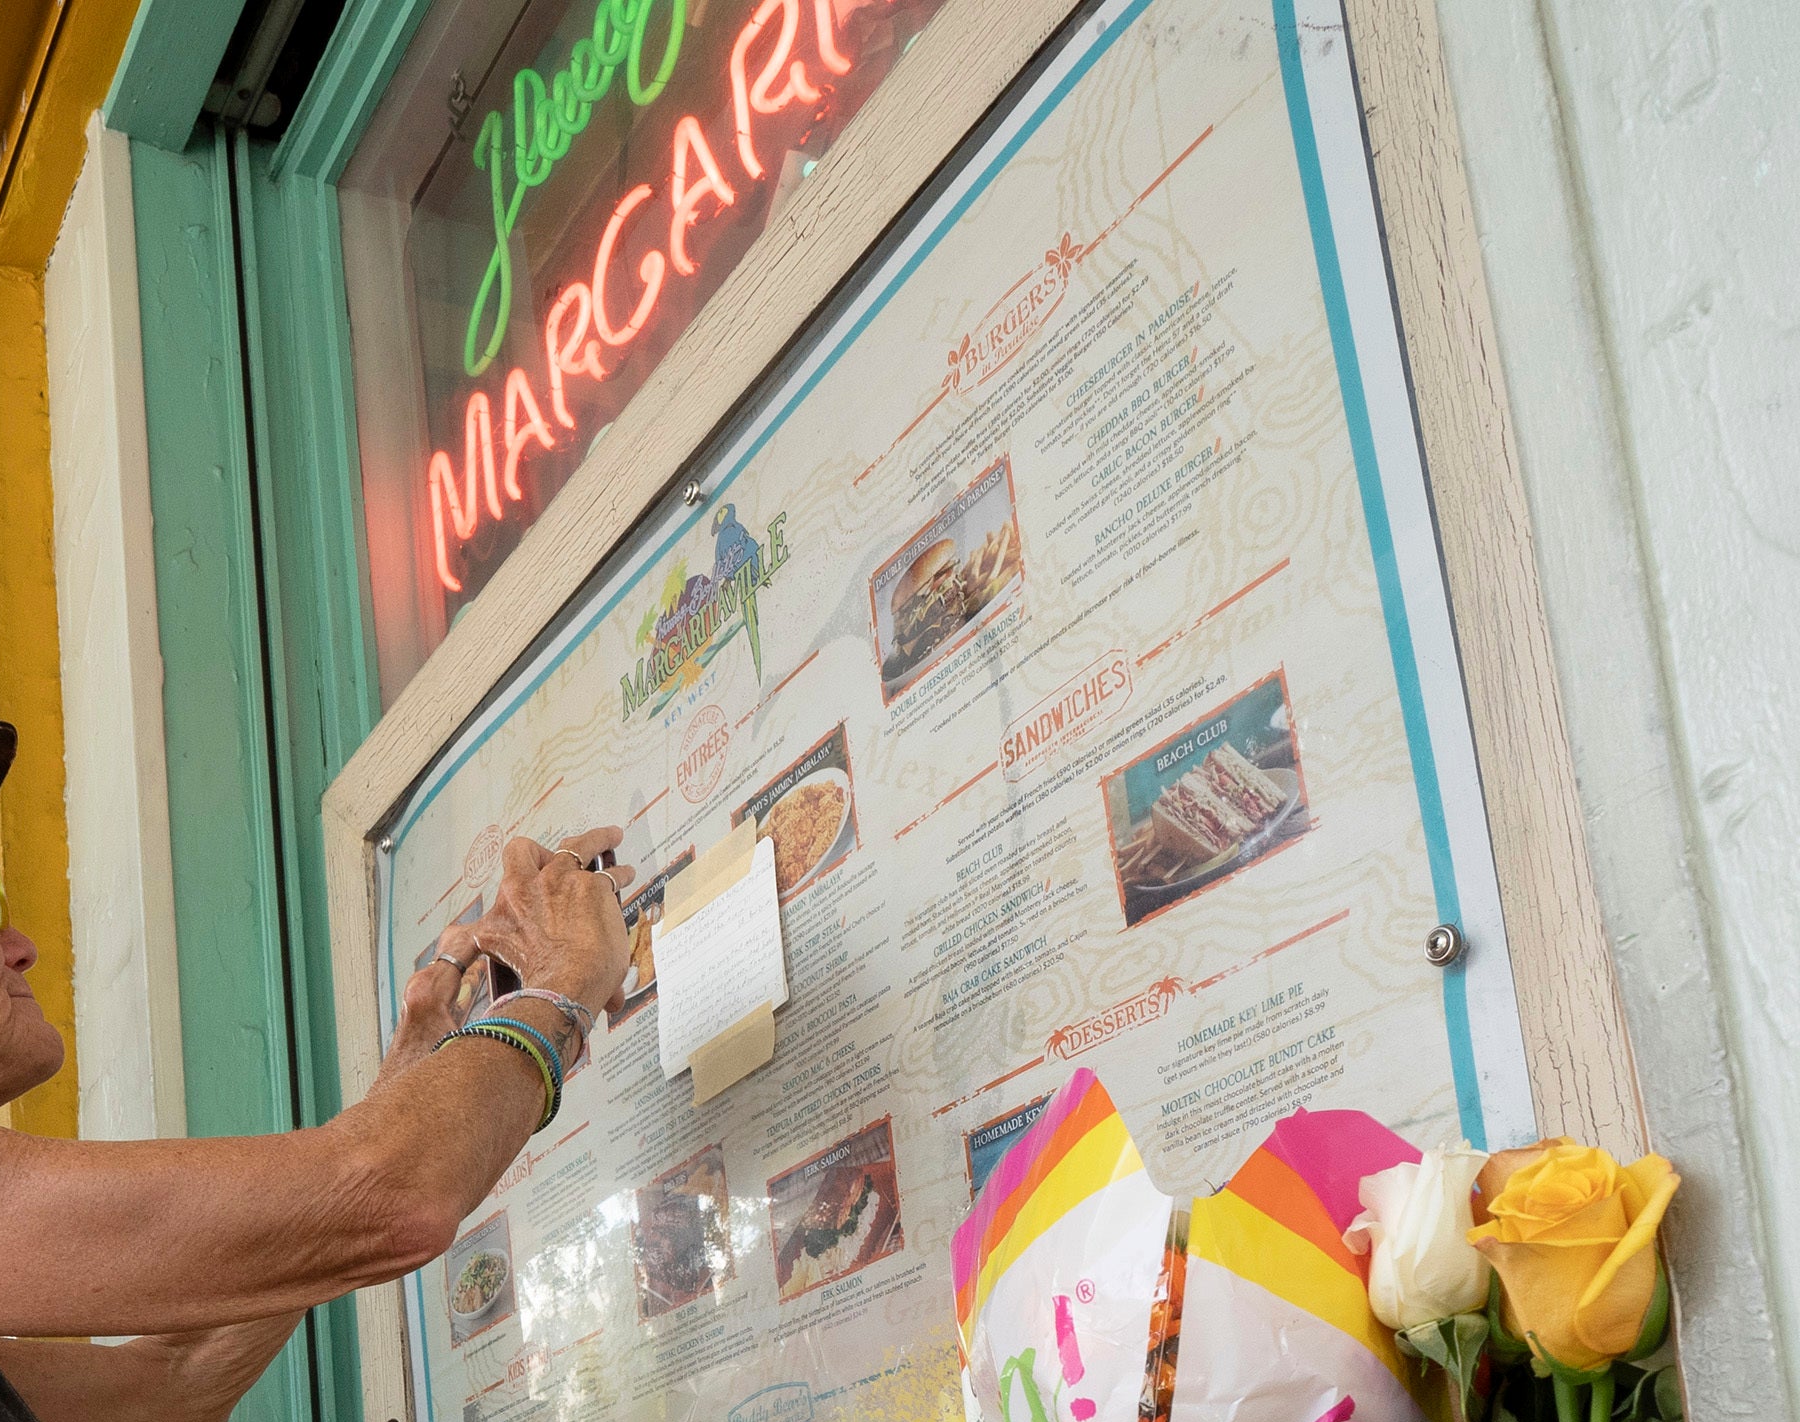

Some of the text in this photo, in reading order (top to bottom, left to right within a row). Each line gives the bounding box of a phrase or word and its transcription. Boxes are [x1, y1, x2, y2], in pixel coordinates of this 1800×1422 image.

[964, 269, 1056, 375] BURGERS
[1066, 342, 1132, 407] CHEESEBURGER
[1134, 330, 1145, 347] IN
[1073, 392, 1093, 414] burger
[1093, 371, 1115, 395] topped
[1116, 360, 1130, 375] with
[1153, 312, 1185, 343] American
[1084, 414, 1096, 429] you
[1097, 404, 1107, 417] are
[1107, 393, 1118, 407] old
[1118, 374, 1142, 398] enough
[1142, 358, 1158, 377] (720
[1159, 333, 1188, 362] calories)
[1086, 354, 1189, 448] CHEDDAR BBQ BURGER
[1091, 393, 1198, 487] GARLIC BACON BURGER
[1094, 446, 1212, 545] RANCHO DELUXE BURGER
[875, 558, 901, 590] DOUBLE
[903, 510, 955, 563] CHEESEBURGER
[956, 500, 965, 515] IN
[620, 511, 789, 722] MARGARITAVILLE
[664, 671, 717, 728] KEY WEST
[890, 692, 916, 721] DOUBLE
[918, 648, 971, 697] CHEESEBURGER
[972, 638, 981, 653] IN
[1003, 660, 1126, 768] SANDWICHES
[676, 722, 730, 787] ENTRÉES
[1156, 719, 1228, 772] BEACH CLUB
[648, 875, 670, 896] COMBO
[956, 843, 1003, 882] BEACH CLUB
[933, 881, 1043, 957] GRILLED CHICKEN SANDWICH
[959, 975, 979, 994] CRAB
[980, 961, 1001, 981] CAKE
[1003, 935, 1046, 969] SANDWICH
[1070, 993, 1160, 1051] DESSERTS
[1156, 988, 1329, 1074] Our signature key lime pie made from scratch daily
[1163, 1072, 1178, 1084] (get
[1178, 1064, 1197, 1079] yours
[1198, 1055, 1216, 1068] while
[1217, 1048, 1232, 1059] they
[1252, 1027, 1270, 1043] (580
[1271, 1012, 1302, 1033] calories)
[1303, 1001, 1325, 1018] $8.99
[1177, 982, 1303, 1052] HOMEMADE KEY LIME PIE
[1161, 1025, 1335, 1116] MOLTEN CHOCOLATE BUNDT CAKE
[803, 1147, 850, 1179] JERK SALMON
[974, 1115, 1023, 1147] HOMEMADE
[1192, 1134, 1219, 1152] caramel
[1220, 1127, 1240, 1140] sauce
[1241, 1116, 1259, 1131] (790
[1260, 1102, 1290, 1122] calories)
[498, 1162, 528, 1196] SALADS
[835, 1275, 862, 1295] SALMON
[507, 1358, 525, 1382] KIDS
